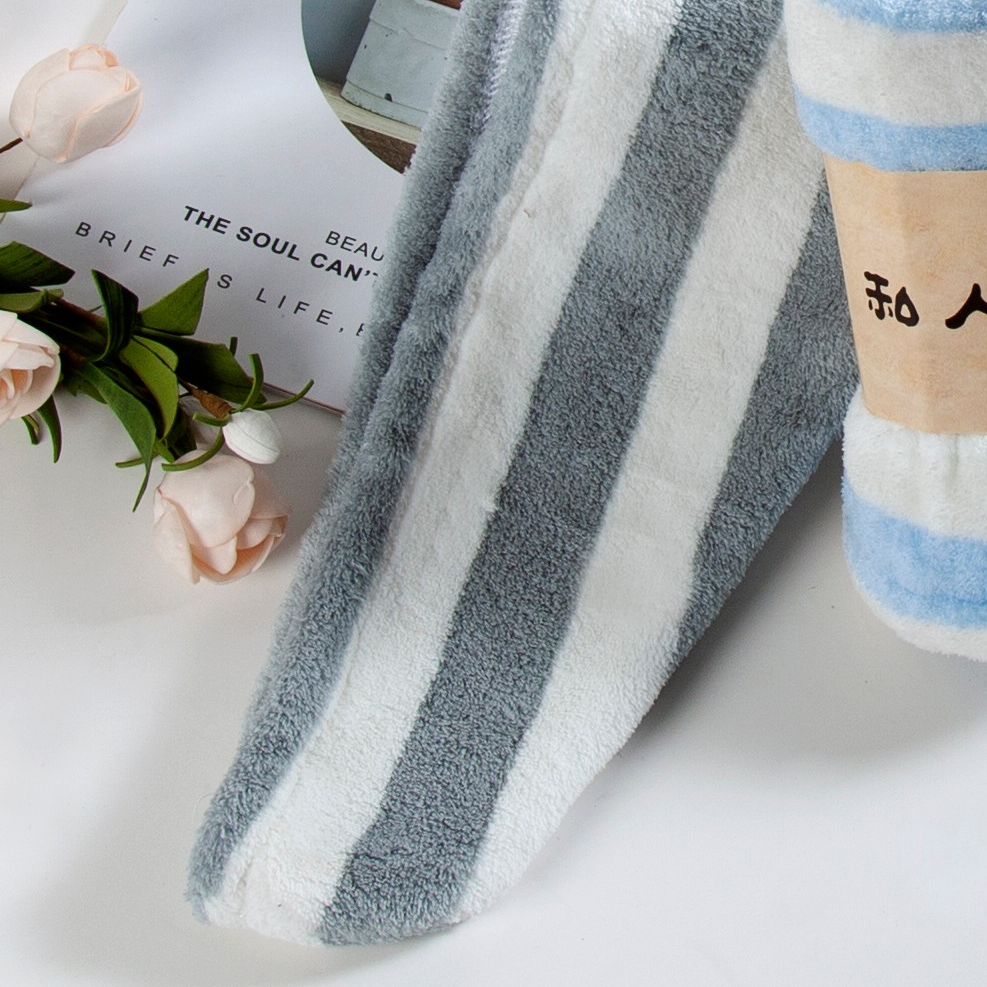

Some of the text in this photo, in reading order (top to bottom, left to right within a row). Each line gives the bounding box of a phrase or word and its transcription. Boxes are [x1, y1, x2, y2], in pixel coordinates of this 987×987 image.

[183, 205, 231, 235] THE
[235, 225, 301, 262] SOUL
[75, 221, 179, 268] BRIEF
[256, 287, 344, 334] LIFE,
